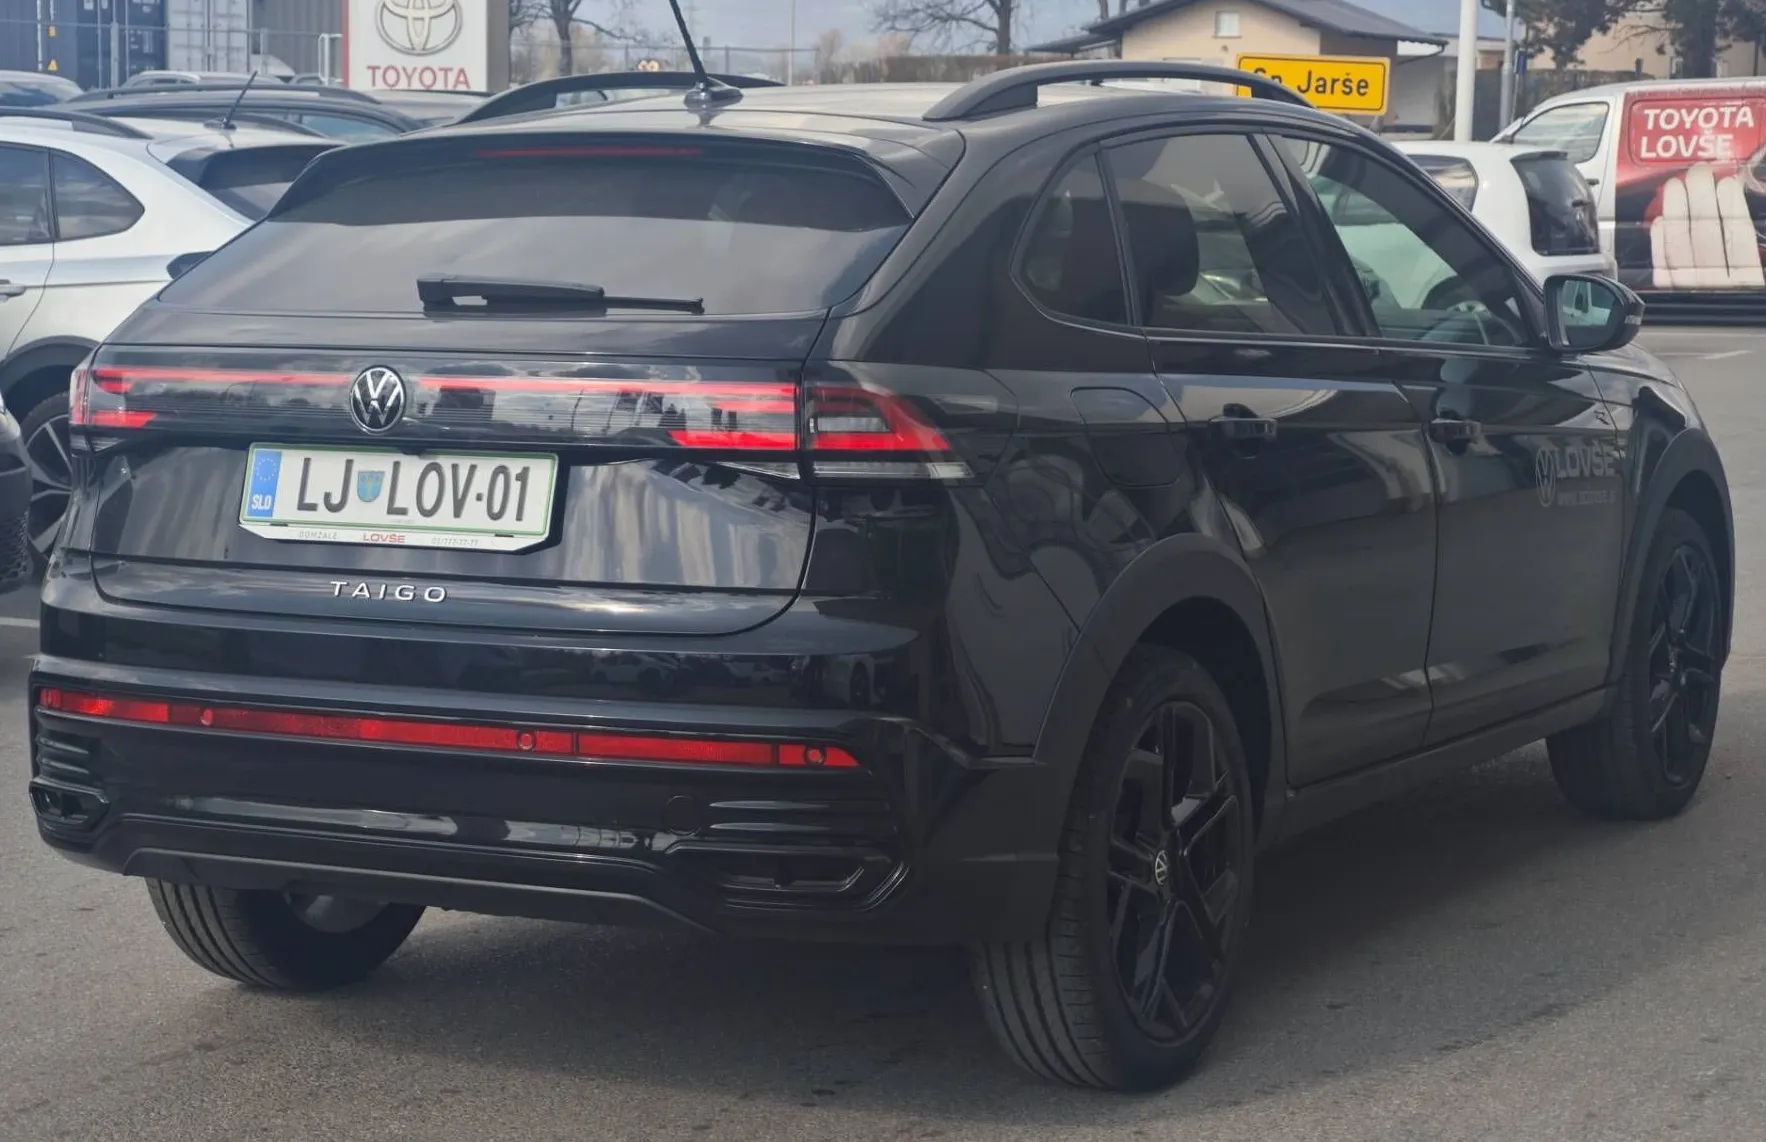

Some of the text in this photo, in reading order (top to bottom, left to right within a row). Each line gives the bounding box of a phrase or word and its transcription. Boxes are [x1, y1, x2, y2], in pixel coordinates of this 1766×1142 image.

[366, 65, 471, 90] TOYOTA
[1297, 69, 1369, 96] Jarše
[1643, 105, 1755, 130] TOYOTA
[1640, 129, 1734, 159] LOVŠE
[297, 457, 354, 513] LJ
[251, 494, 272, 510] SLO
[330, 580, 447, 603] TAIGO
